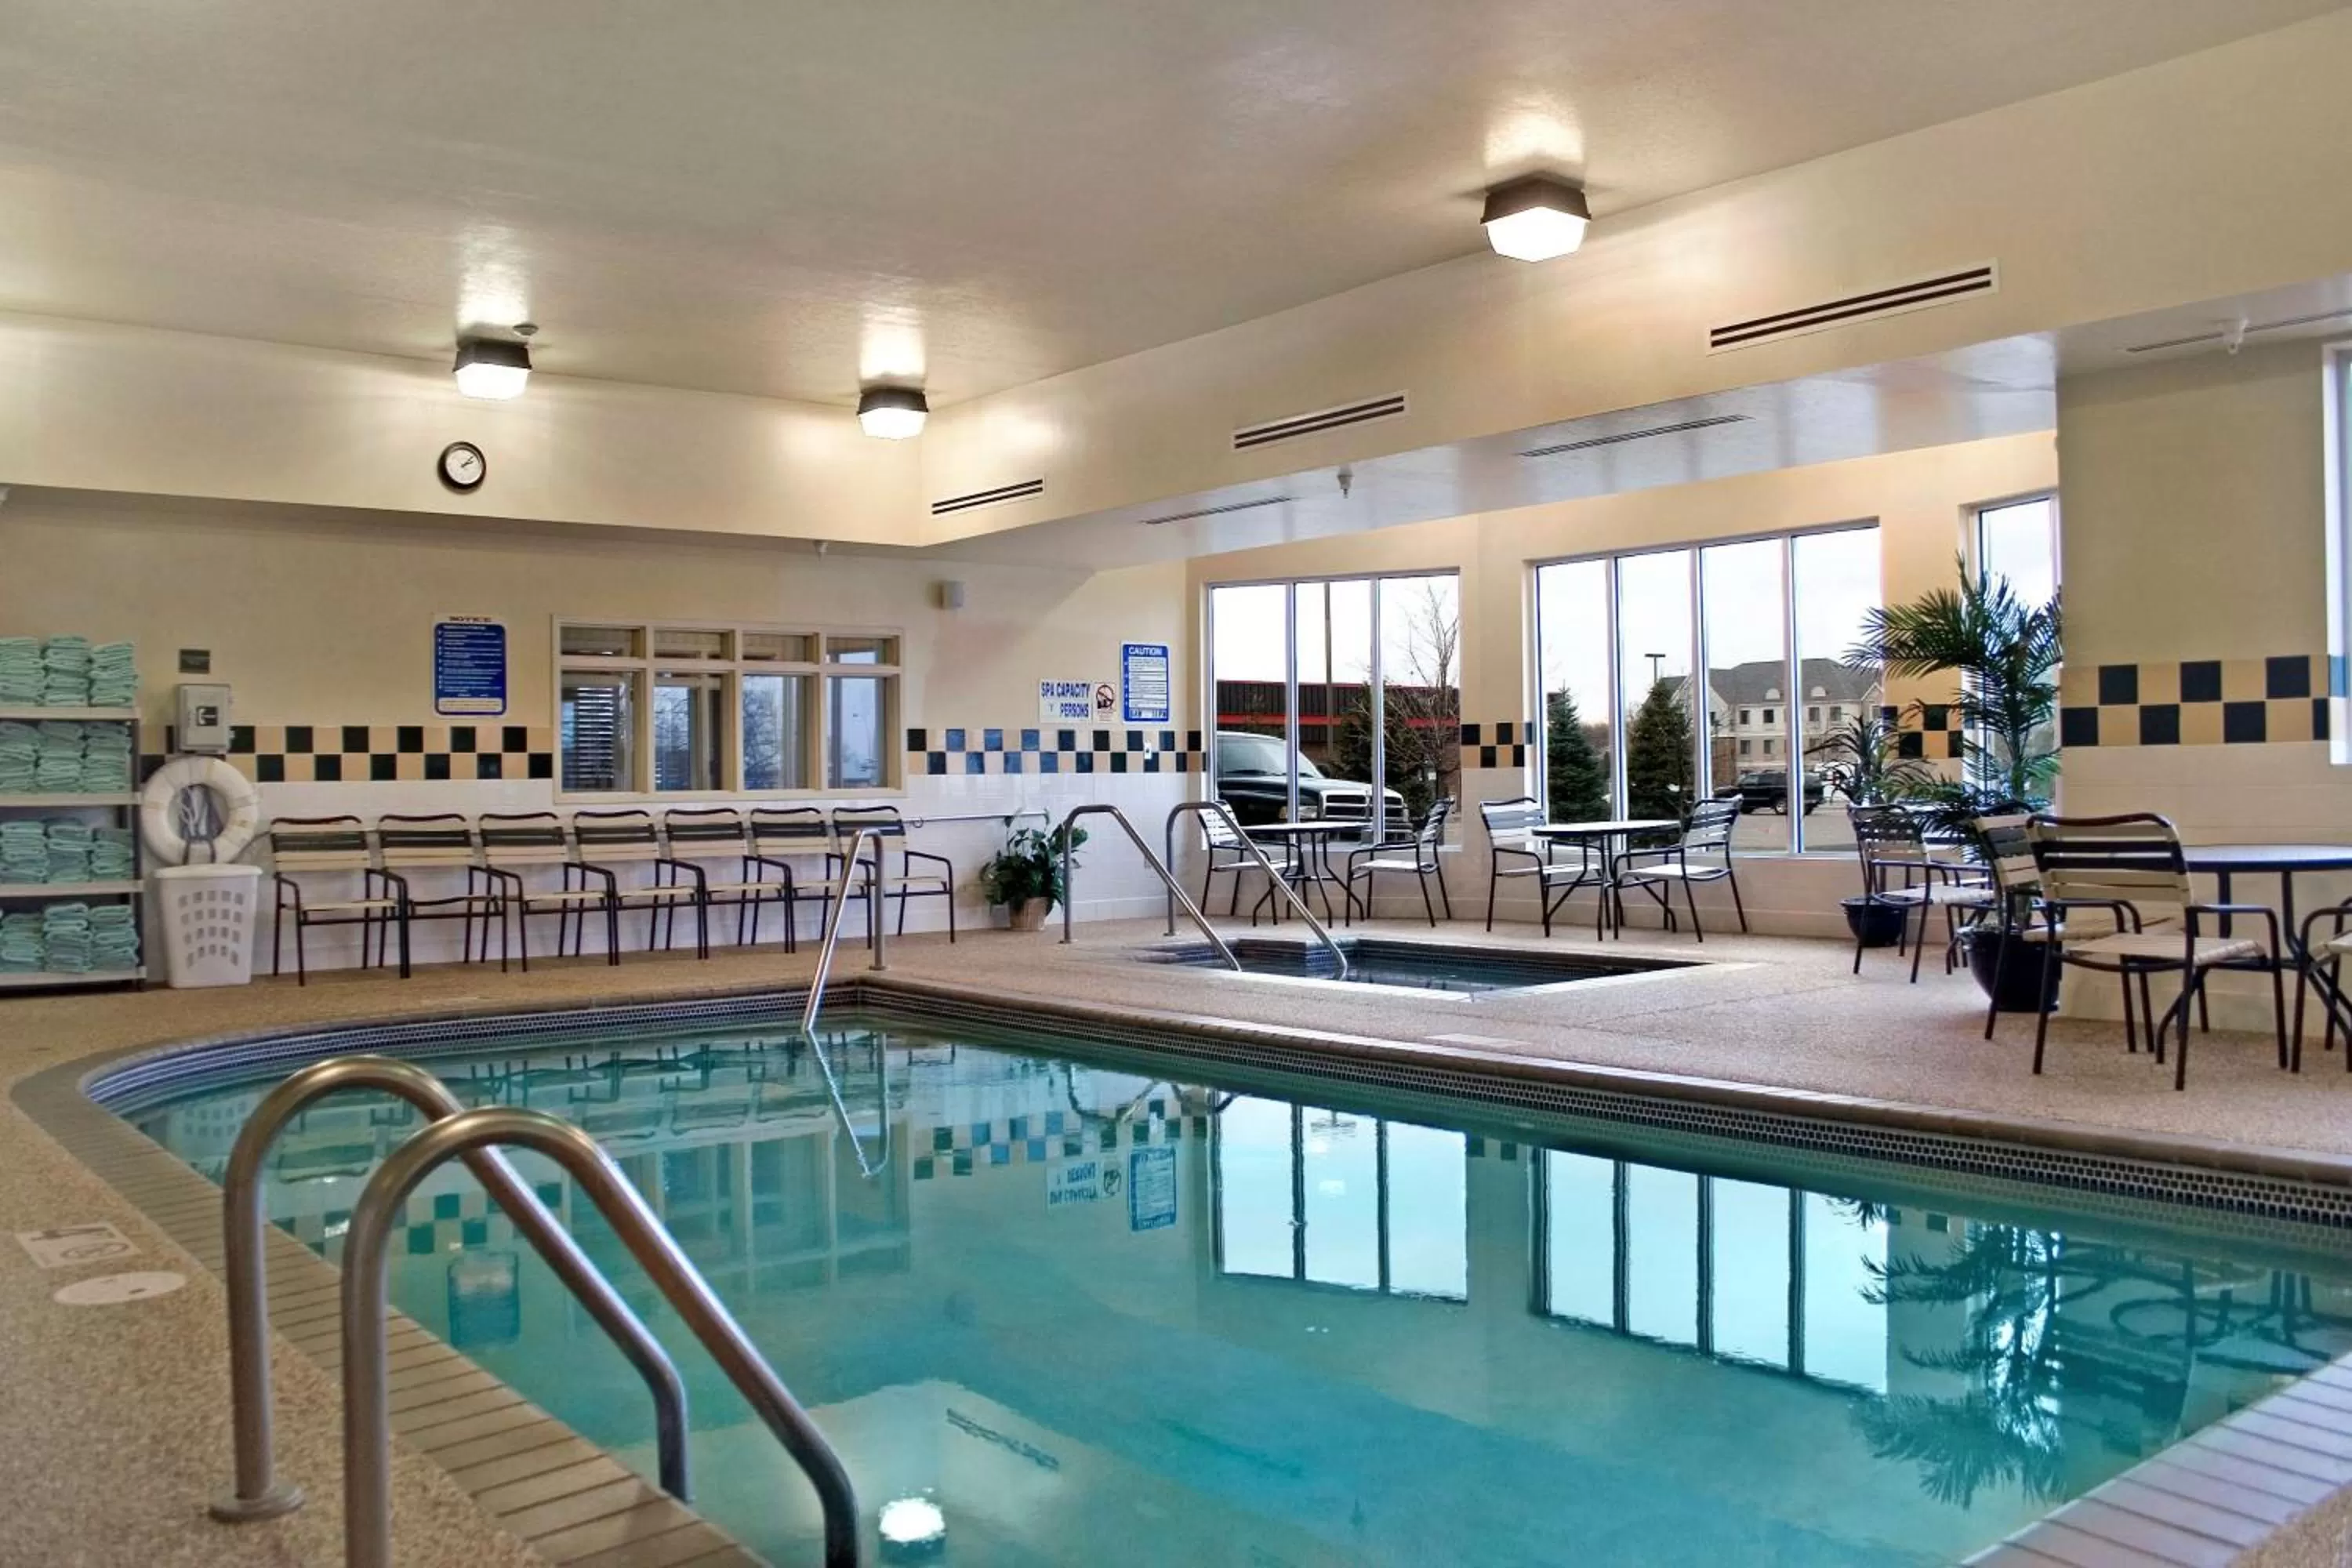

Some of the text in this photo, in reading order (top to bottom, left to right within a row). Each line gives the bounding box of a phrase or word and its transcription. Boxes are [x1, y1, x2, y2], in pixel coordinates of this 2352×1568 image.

[1128, 647, 1163, 655] CAUTION
[1041, 682, 1090, 698] SPA CAPACITY
[1060, 702, 1089, 717] PERSONS
